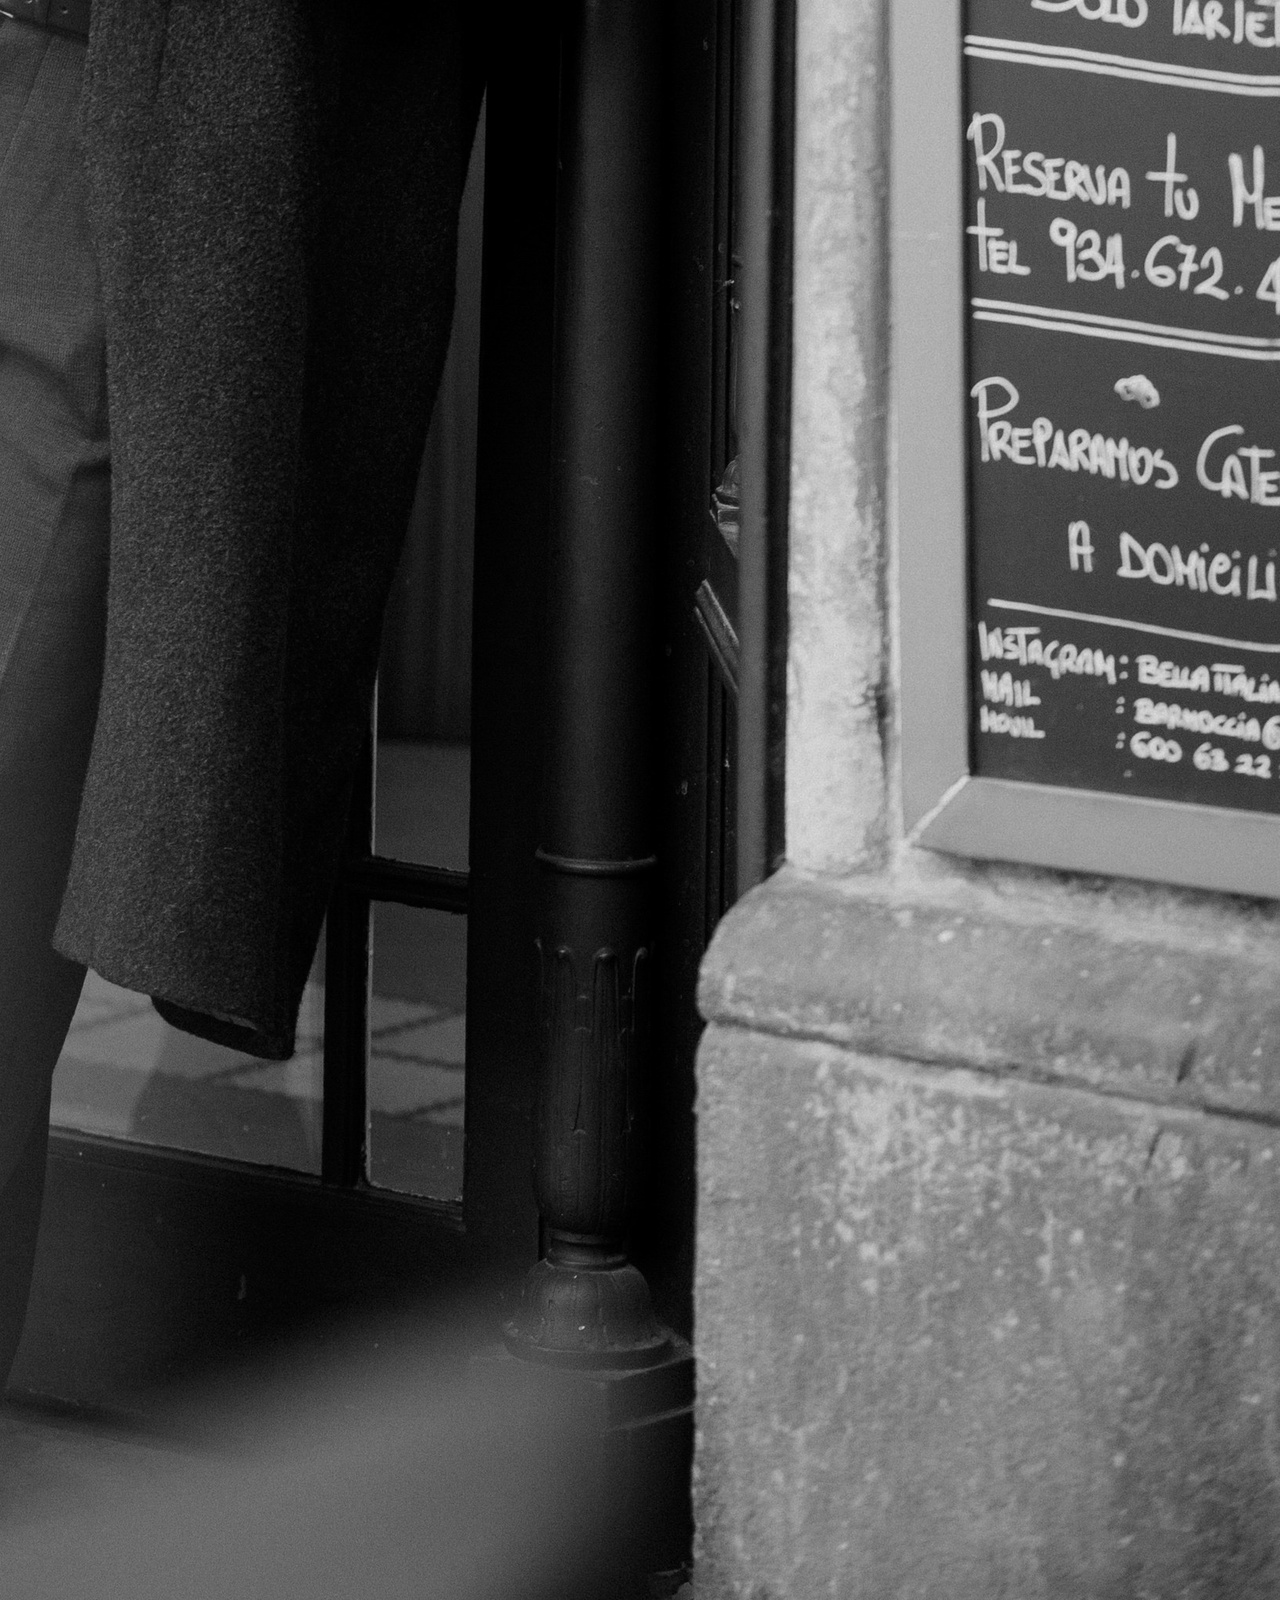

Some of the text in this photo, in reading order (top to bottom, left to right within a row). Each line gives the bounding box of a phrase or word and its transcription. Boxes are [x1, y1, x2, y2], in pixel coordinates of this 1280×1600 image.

[966, 112, 1131, 212] RESERVA
[970, 374, 1179, 490] PREPARAMOS
[1067, 520, 1095, 573] A
[980, 669, 1042, 708] MAIL
